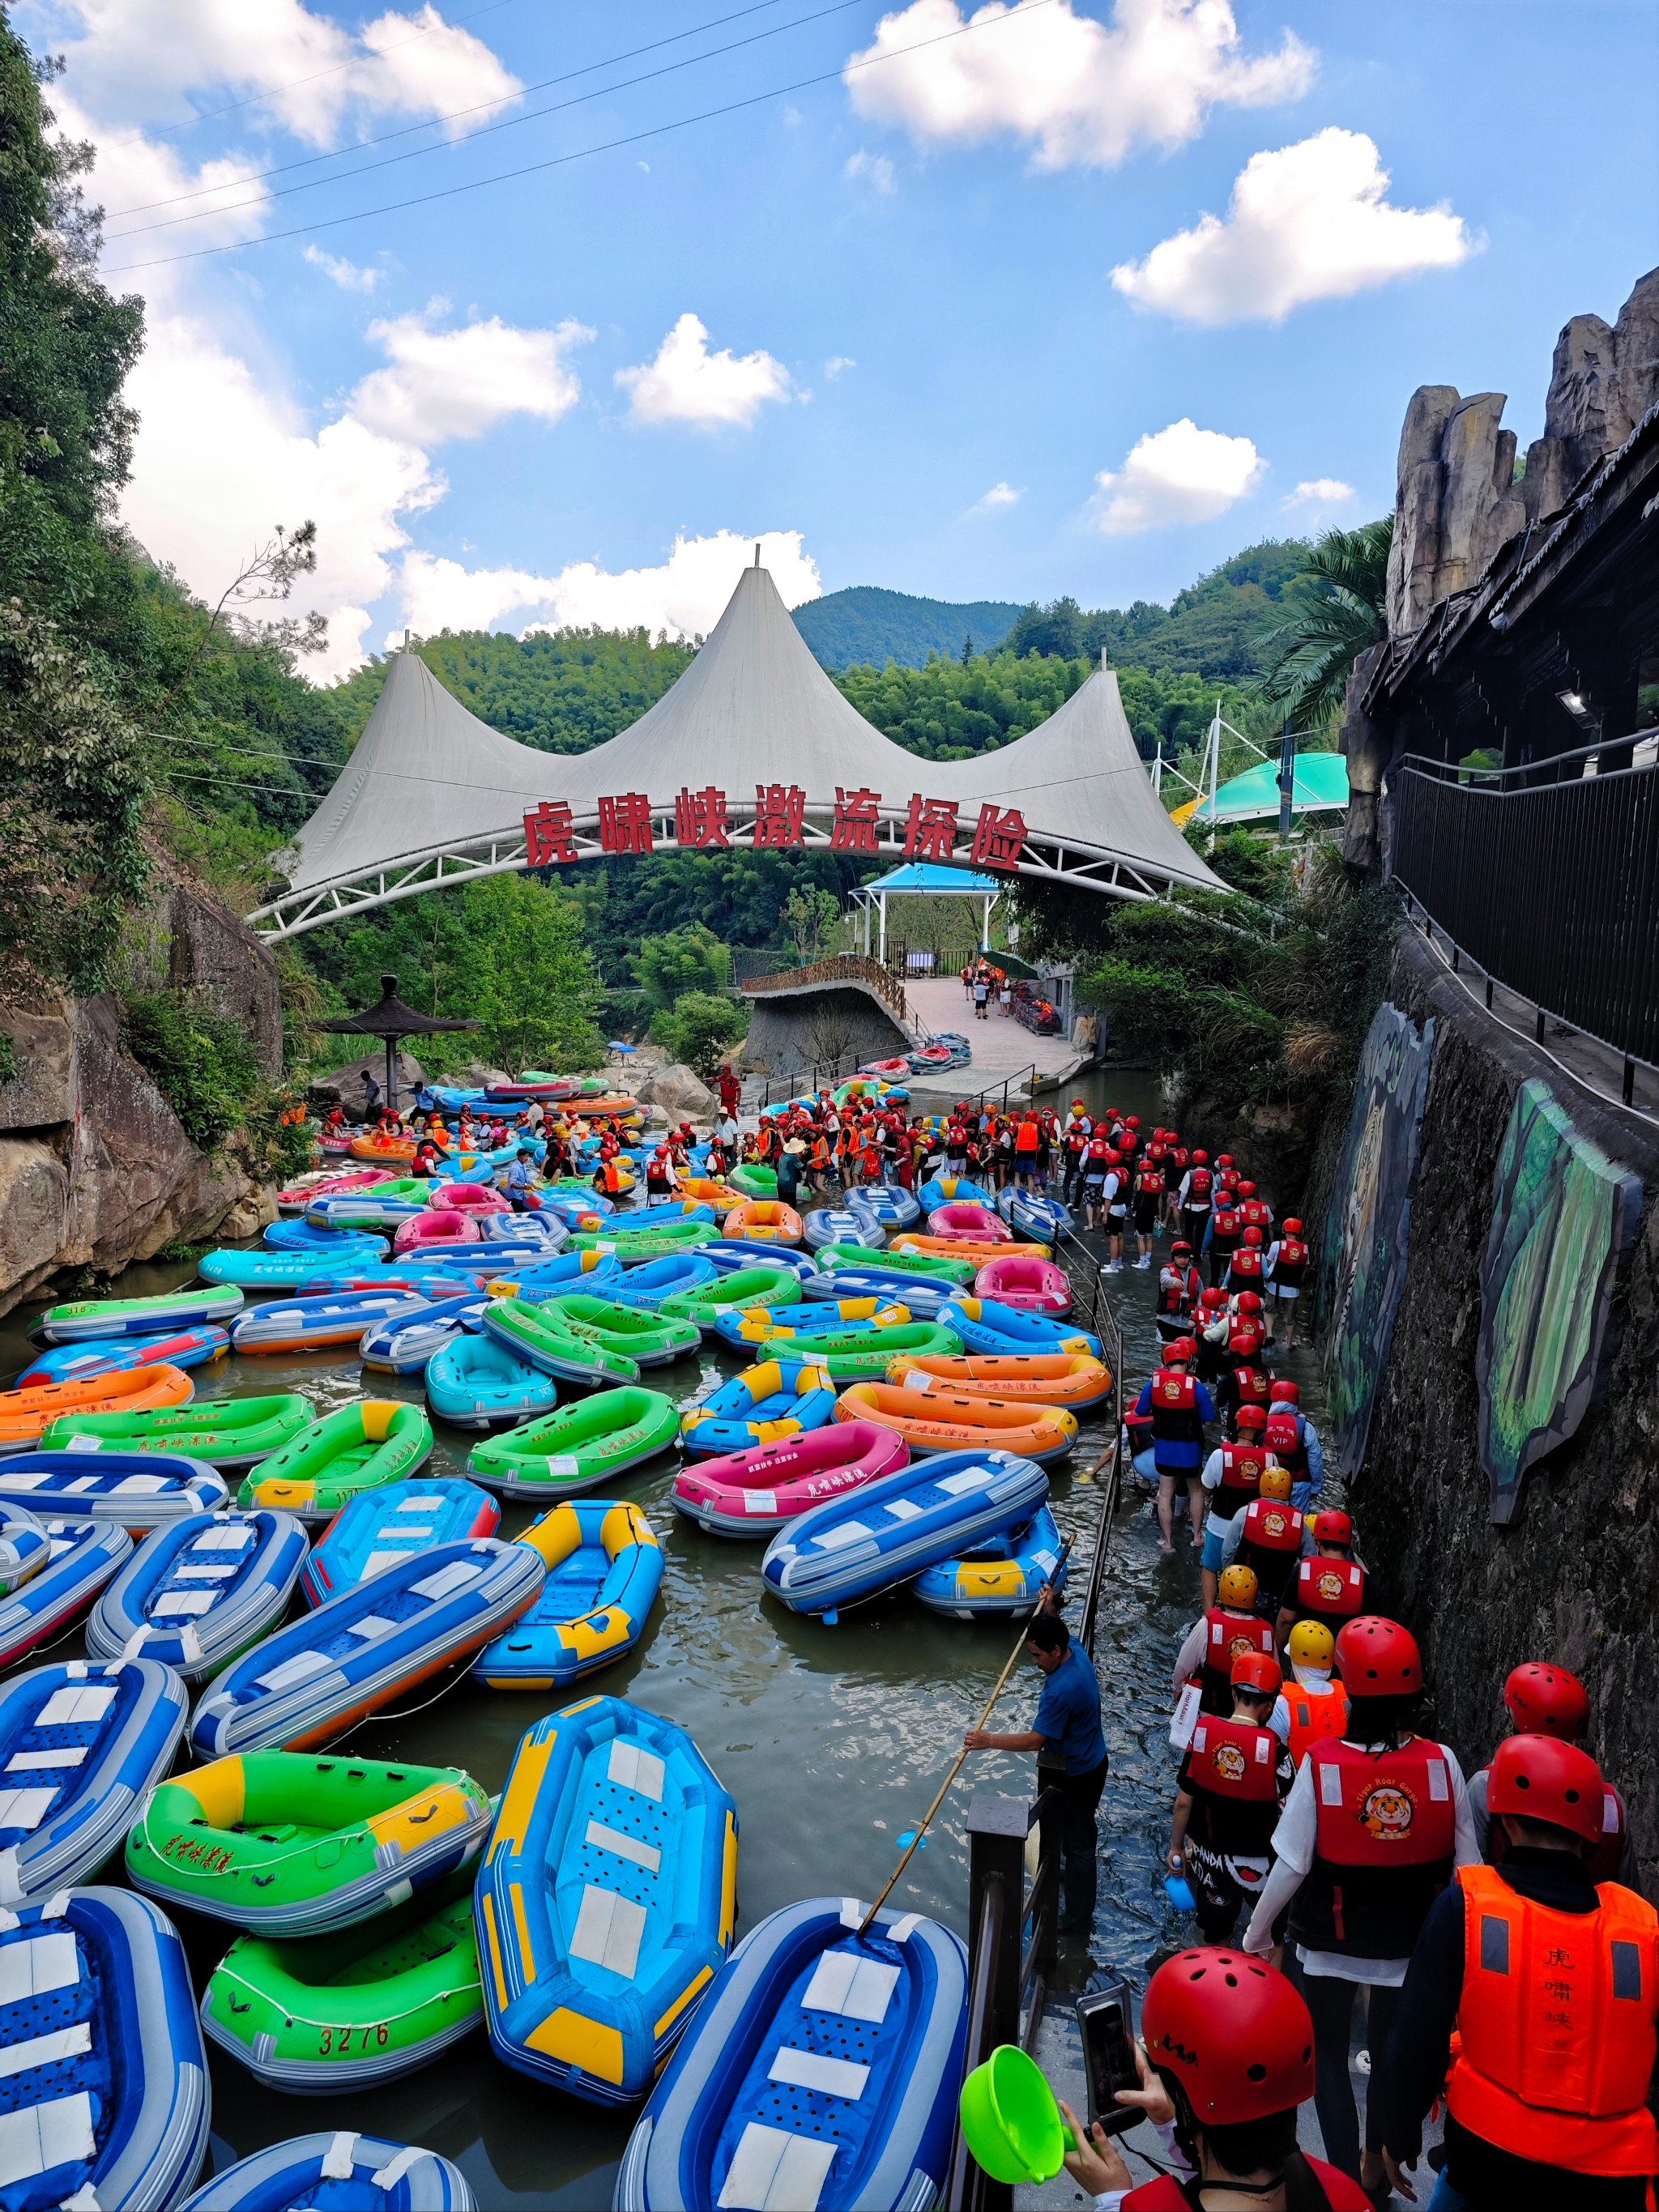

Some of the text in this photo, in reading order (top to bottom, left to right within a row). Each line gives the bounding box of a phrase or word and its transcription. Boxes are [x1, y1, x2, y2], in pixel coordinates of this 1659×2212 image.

[522, 782, 1028, 872] 虎啸峡激流探险
[1273, 1436, 1288, 1445] VIP
[1356, 1778, 1418, 1805] Tiger Roar Gorge
[1543, 1946, 1576, 2031] 虎啸峡
[318, 2023, 390, 2055] 3276
